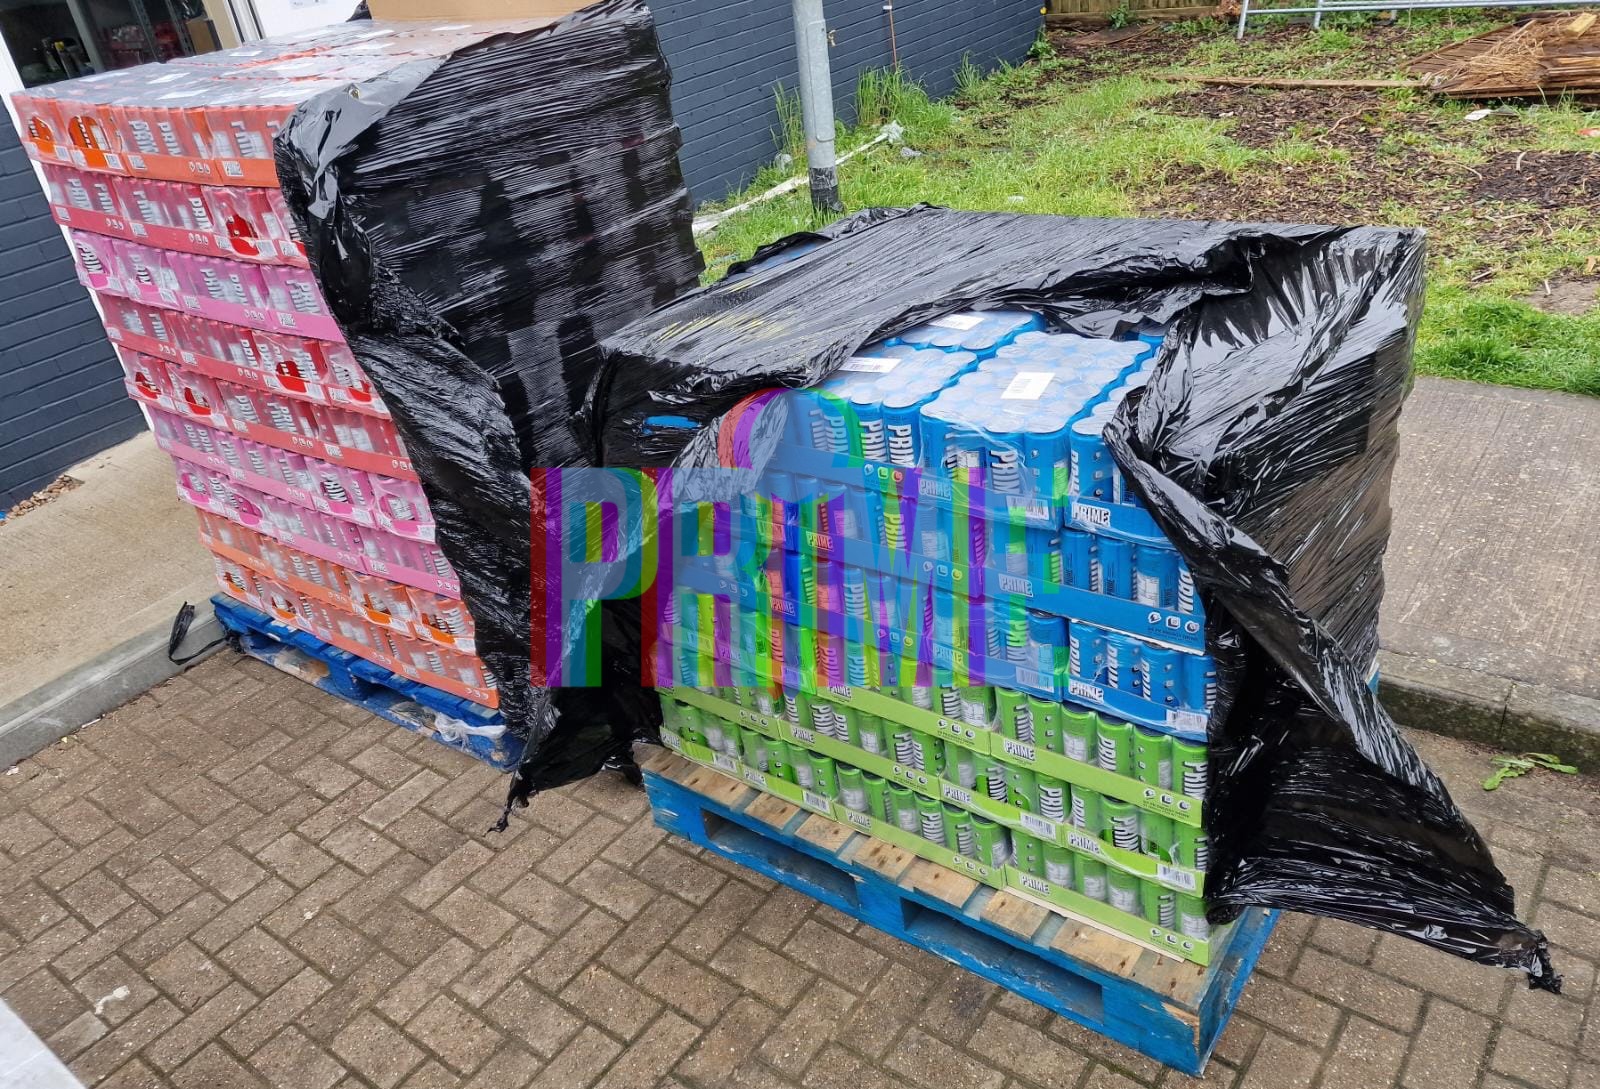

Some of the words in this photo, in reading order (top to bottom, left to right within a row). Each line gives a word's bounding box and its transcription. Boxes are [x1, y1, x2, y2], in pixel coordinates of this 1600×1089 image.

[1072, 502, 1111, 528] PRIME
[806, 531, 834, 551] PRIME
[999, 575, 1033, 596] PRIME
[770, 596, 795, 616] PRIME
[1070, 680, 1104, 703] PRIME
[1005, 741, 1035, 761] PRIME
[943, 783, 970, 803] PRIME
[1069, 832, 1099, 853] PRIME
[1021, 874, 1050, 894] PRIME
